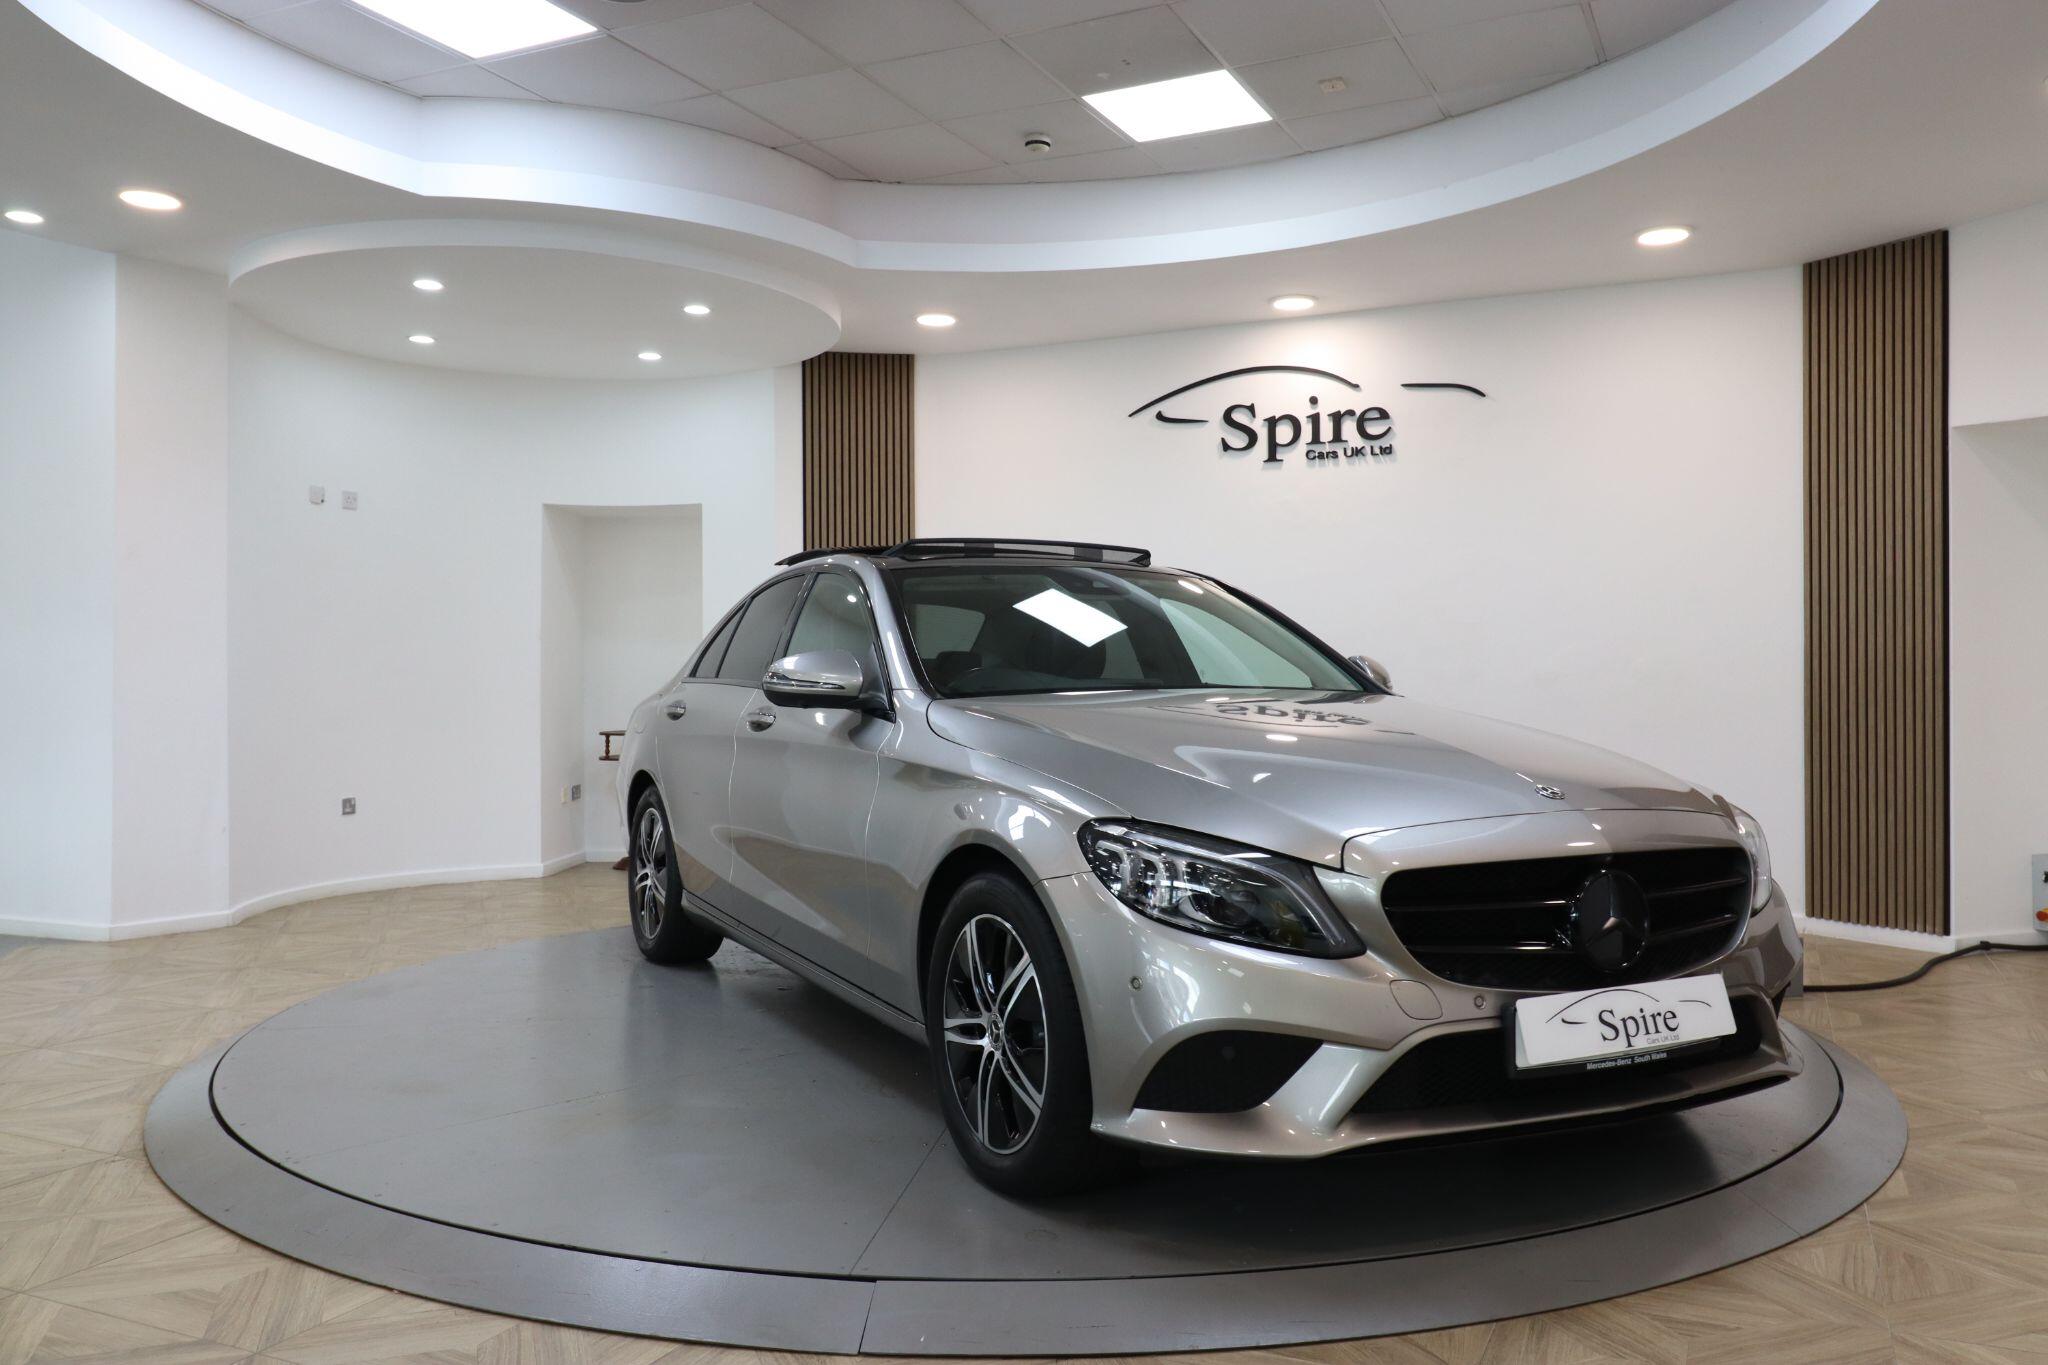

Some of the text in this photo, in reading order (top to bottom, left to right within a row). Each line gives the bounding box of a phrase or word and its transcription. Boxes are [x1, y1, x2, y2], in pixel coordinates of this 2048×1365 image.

[1220, 395, 1393, 463] Spire
[1305, 443, 1393, 461] Cars UK Ltd
[1598, 1008, 1680, 1049] Spire
[1586, 1058, 1632, 1070] Mercedes-Benz
[1634, 1055, 1651, 1064] South
